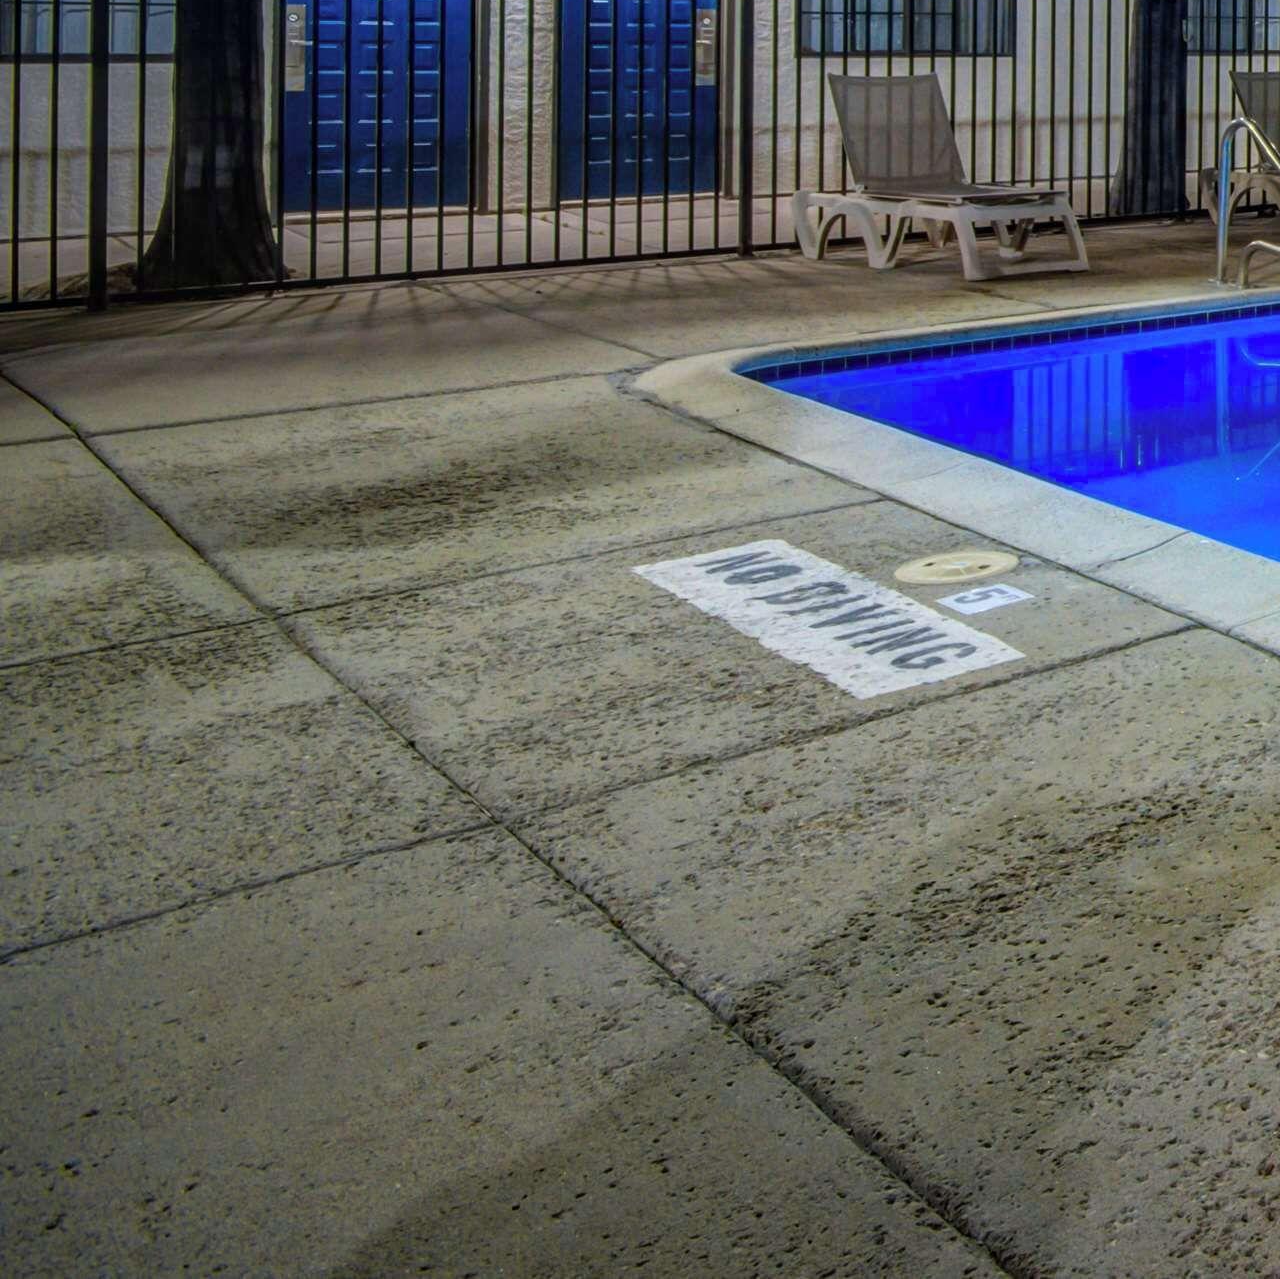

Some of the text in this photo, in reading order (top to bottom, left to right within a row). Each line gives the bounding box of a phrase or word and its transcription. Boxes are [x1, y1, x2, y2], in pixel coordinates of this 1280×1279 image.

[692, 550, 978, 671] NO DIVING
[953, 587, 1010, 604] 5
